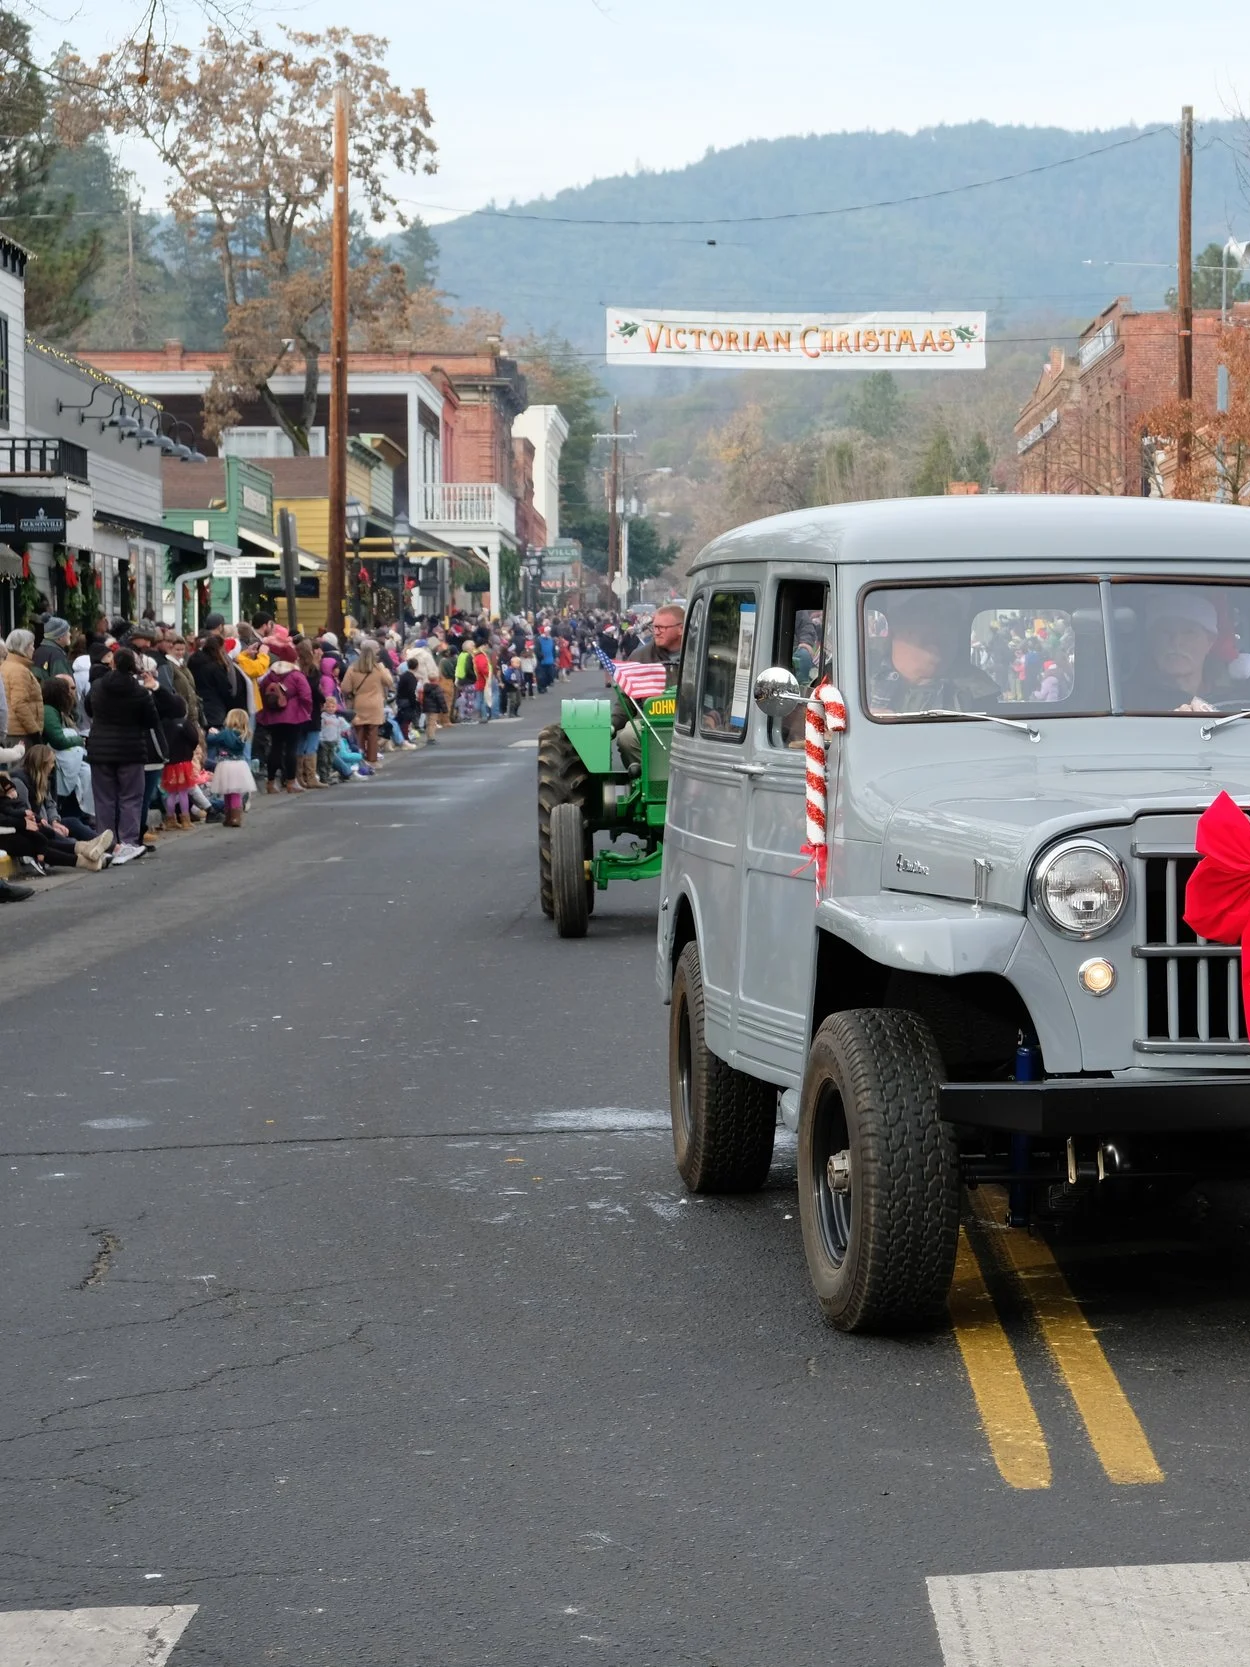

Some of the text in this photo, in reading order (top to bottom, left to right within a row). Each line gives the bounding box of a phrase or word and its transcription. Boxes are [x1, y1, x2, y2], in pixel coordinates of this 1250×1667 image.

[645, 324, 955, 358] VICTORIAN CHRISTMAS
[649, 699, 676, 714] JOHN
